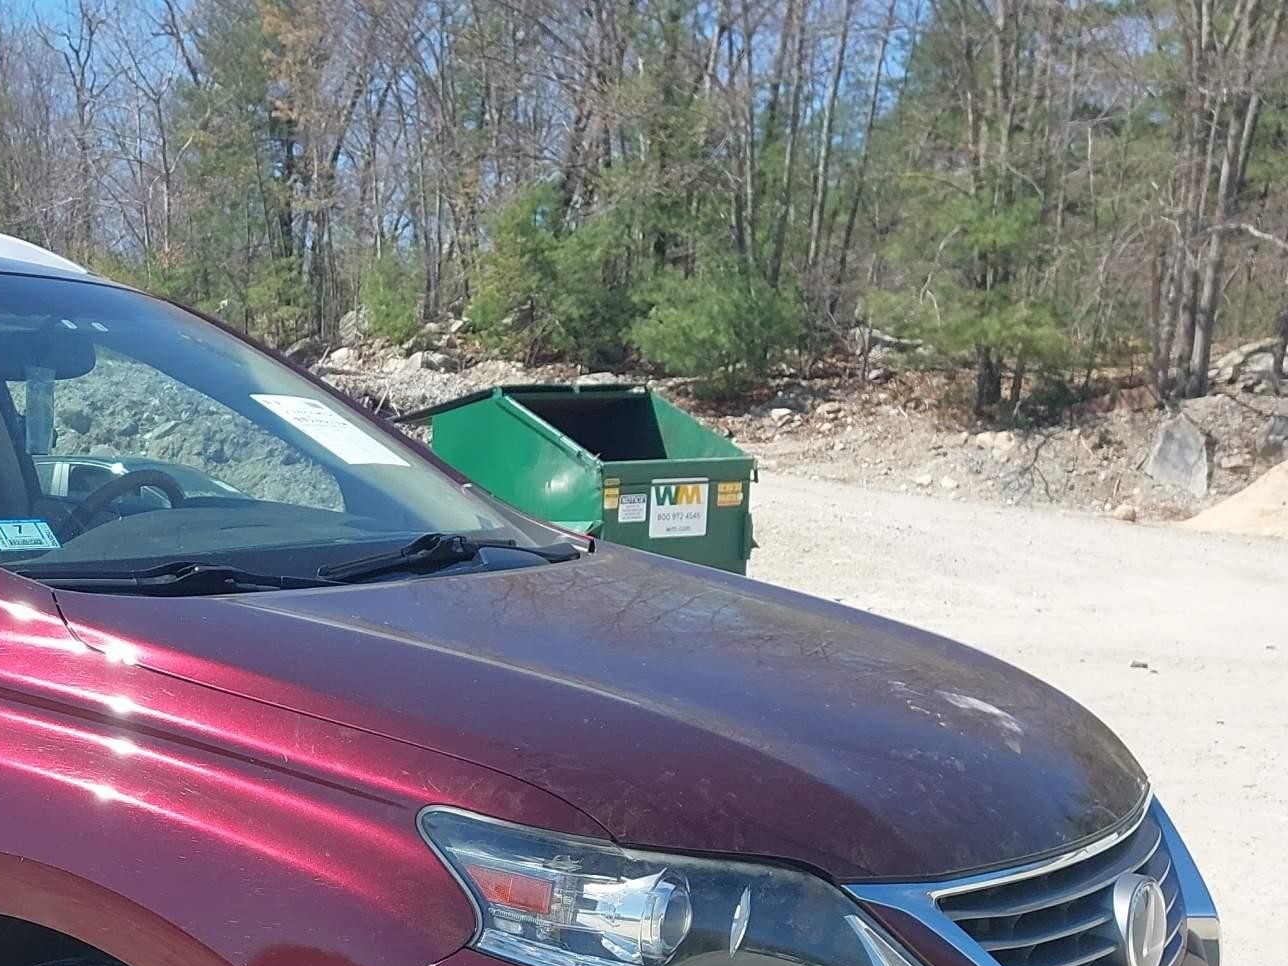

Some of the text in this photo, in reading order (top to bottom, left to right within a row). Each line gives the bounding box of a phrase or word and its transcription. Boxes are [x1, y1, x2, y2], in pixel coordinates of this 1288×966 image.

[655, 485, 701, 506] WM
[657, 512, 671, 521] 800
[13, 524, 23, 534] 7
